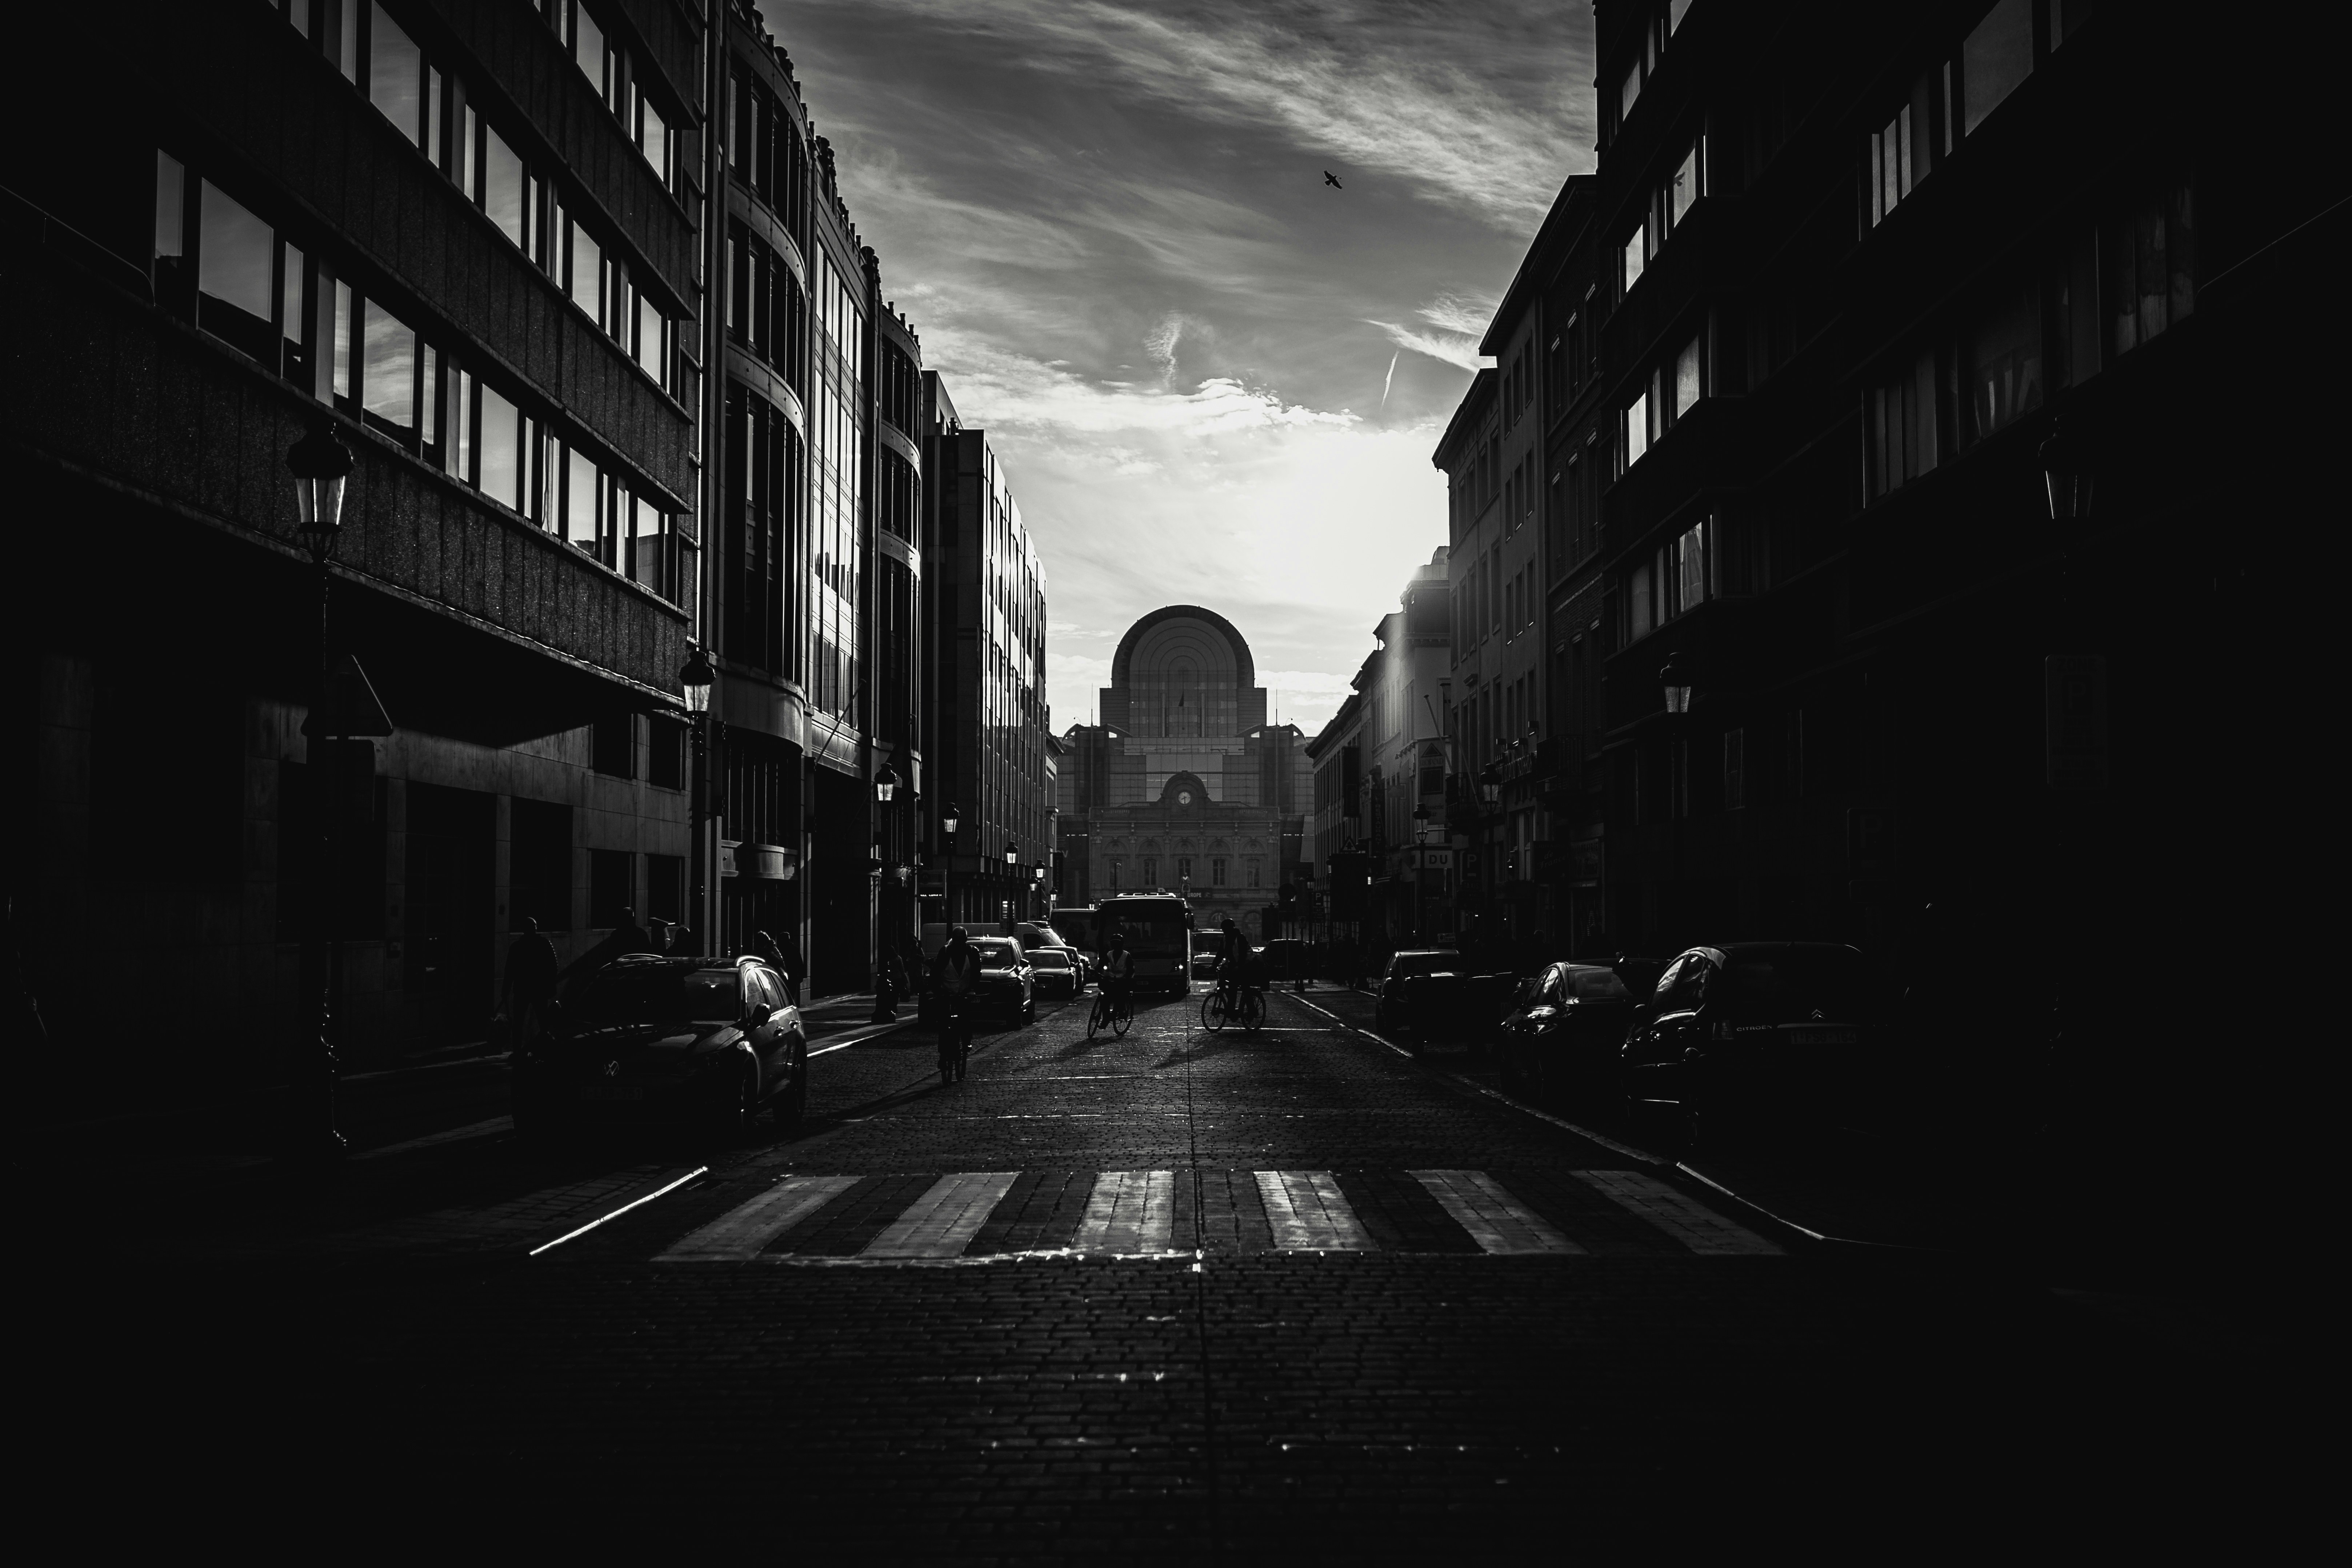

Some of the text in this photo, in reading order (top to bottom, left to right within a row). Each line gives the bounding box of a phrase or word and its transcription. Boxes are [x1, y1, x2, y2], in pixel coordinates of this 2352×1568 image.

[2057, 658, 2098, 672] ZONE
[2068, 681, 2087, 709] P
[1429, 855, 1448, 864] DU
[1467, 854, 1477, 868] P
[1544, 850, 1554, 859] de
[1536, 855, 1566, 871] France
[1315, 893, 1321, 901] P
